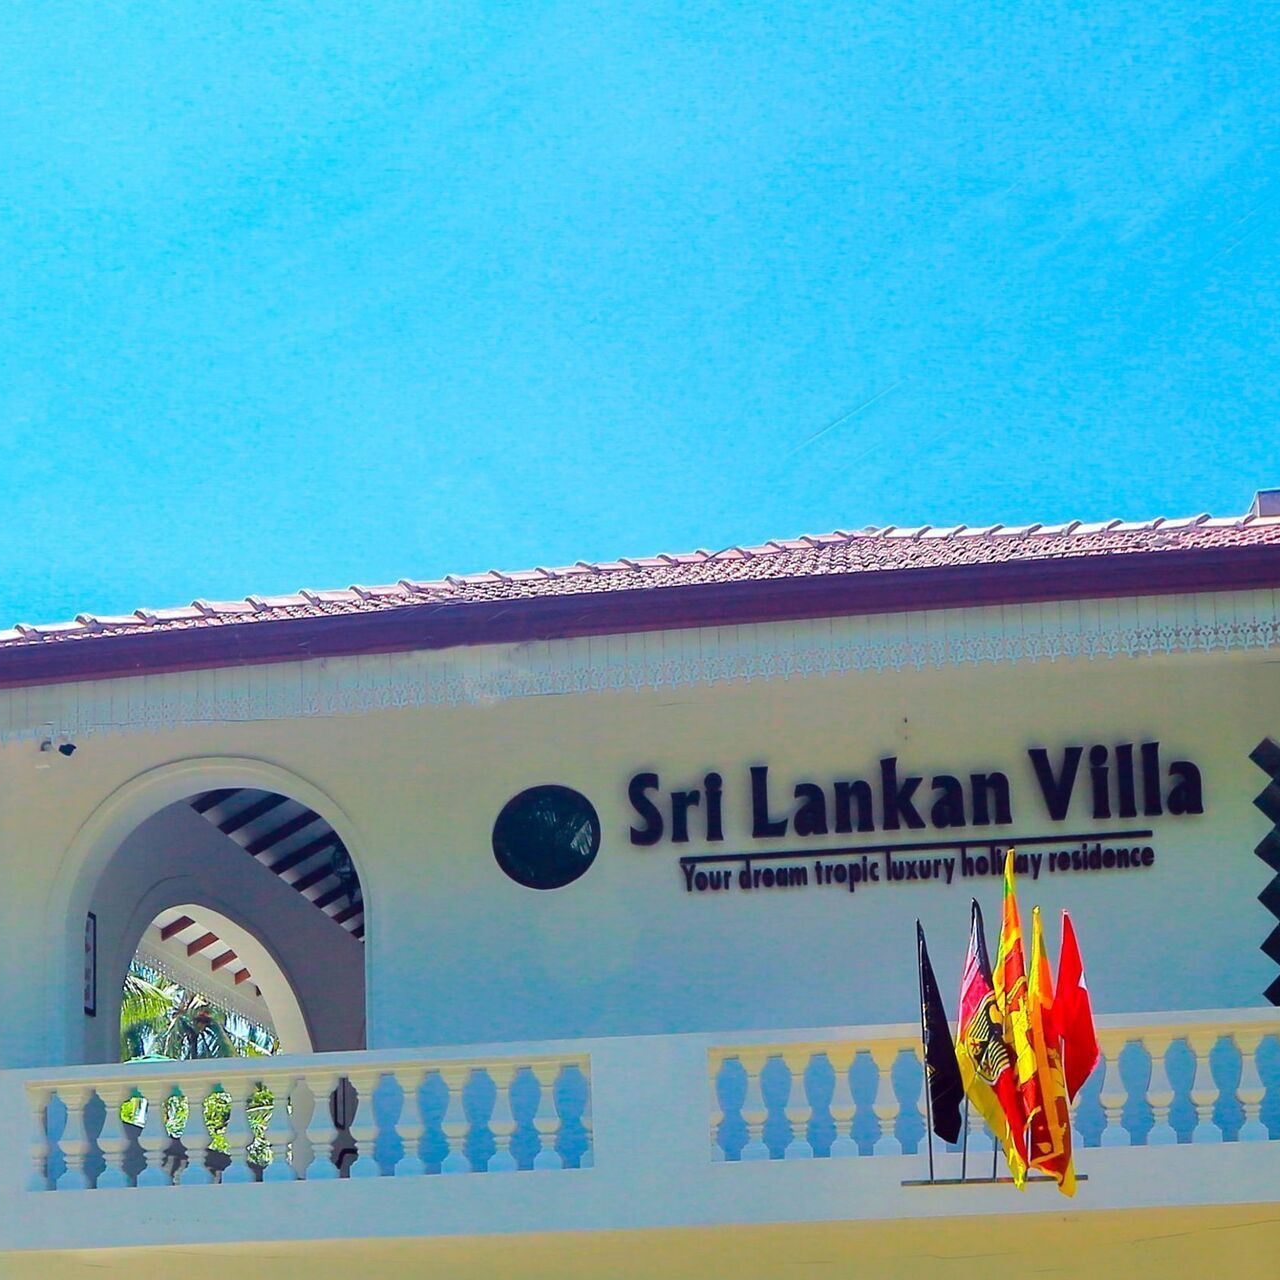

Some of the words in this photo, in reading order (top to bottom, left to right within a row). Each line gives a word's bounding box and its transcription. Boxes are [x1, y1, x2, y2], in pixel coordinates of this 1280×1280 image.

[628, 772, 724, 846] Sri
[750, 757, 1013, 839] Lankan
[1027, 741, 1204, 821] Villa
[680, 863, 732, 892] Your
[738, 858, 808, 889] dream
[815, 856, 880, 892] tropic
[886, 850, 955, 885] luxury
[1049, 842, 1155, 872] residence
